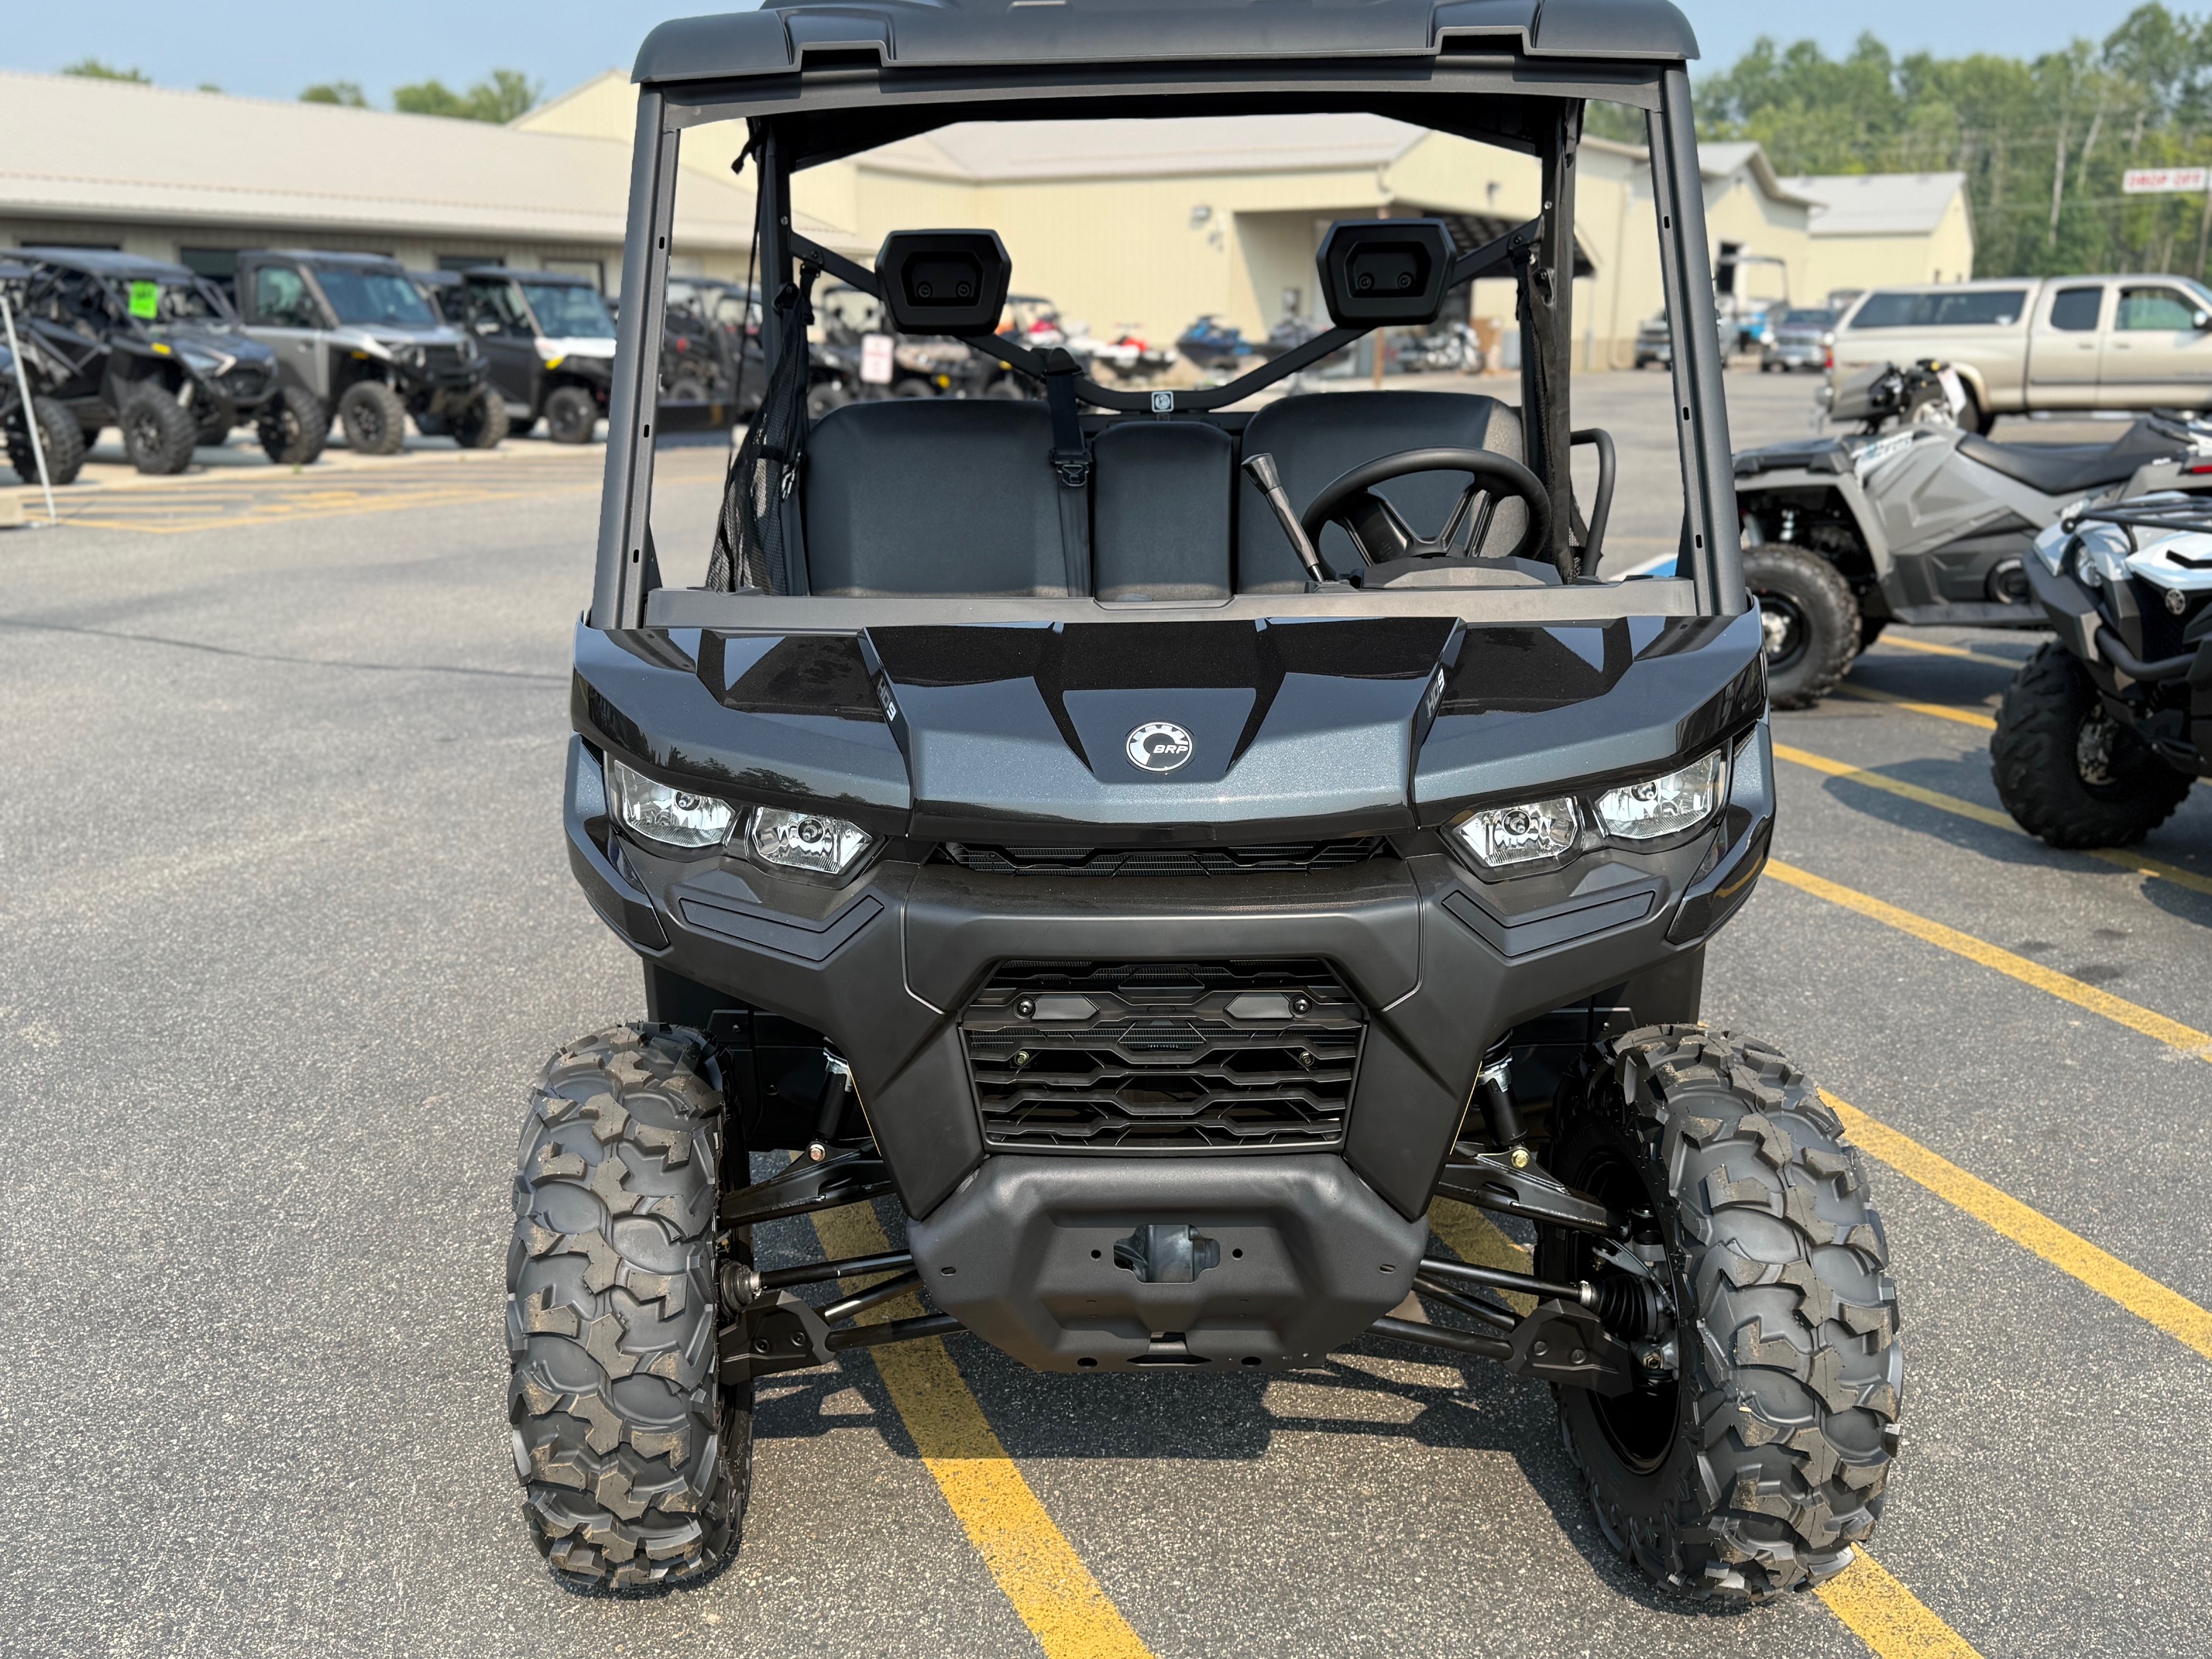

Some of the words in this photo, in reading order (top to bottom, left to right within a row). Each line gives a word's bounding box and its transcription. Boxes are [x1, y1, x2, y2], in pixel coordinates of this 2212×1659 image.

[877, 676, 897, 722] HD9
[1427, 668, 1445, 718] HD9
[1152, 744, 1189, 754] BRP
